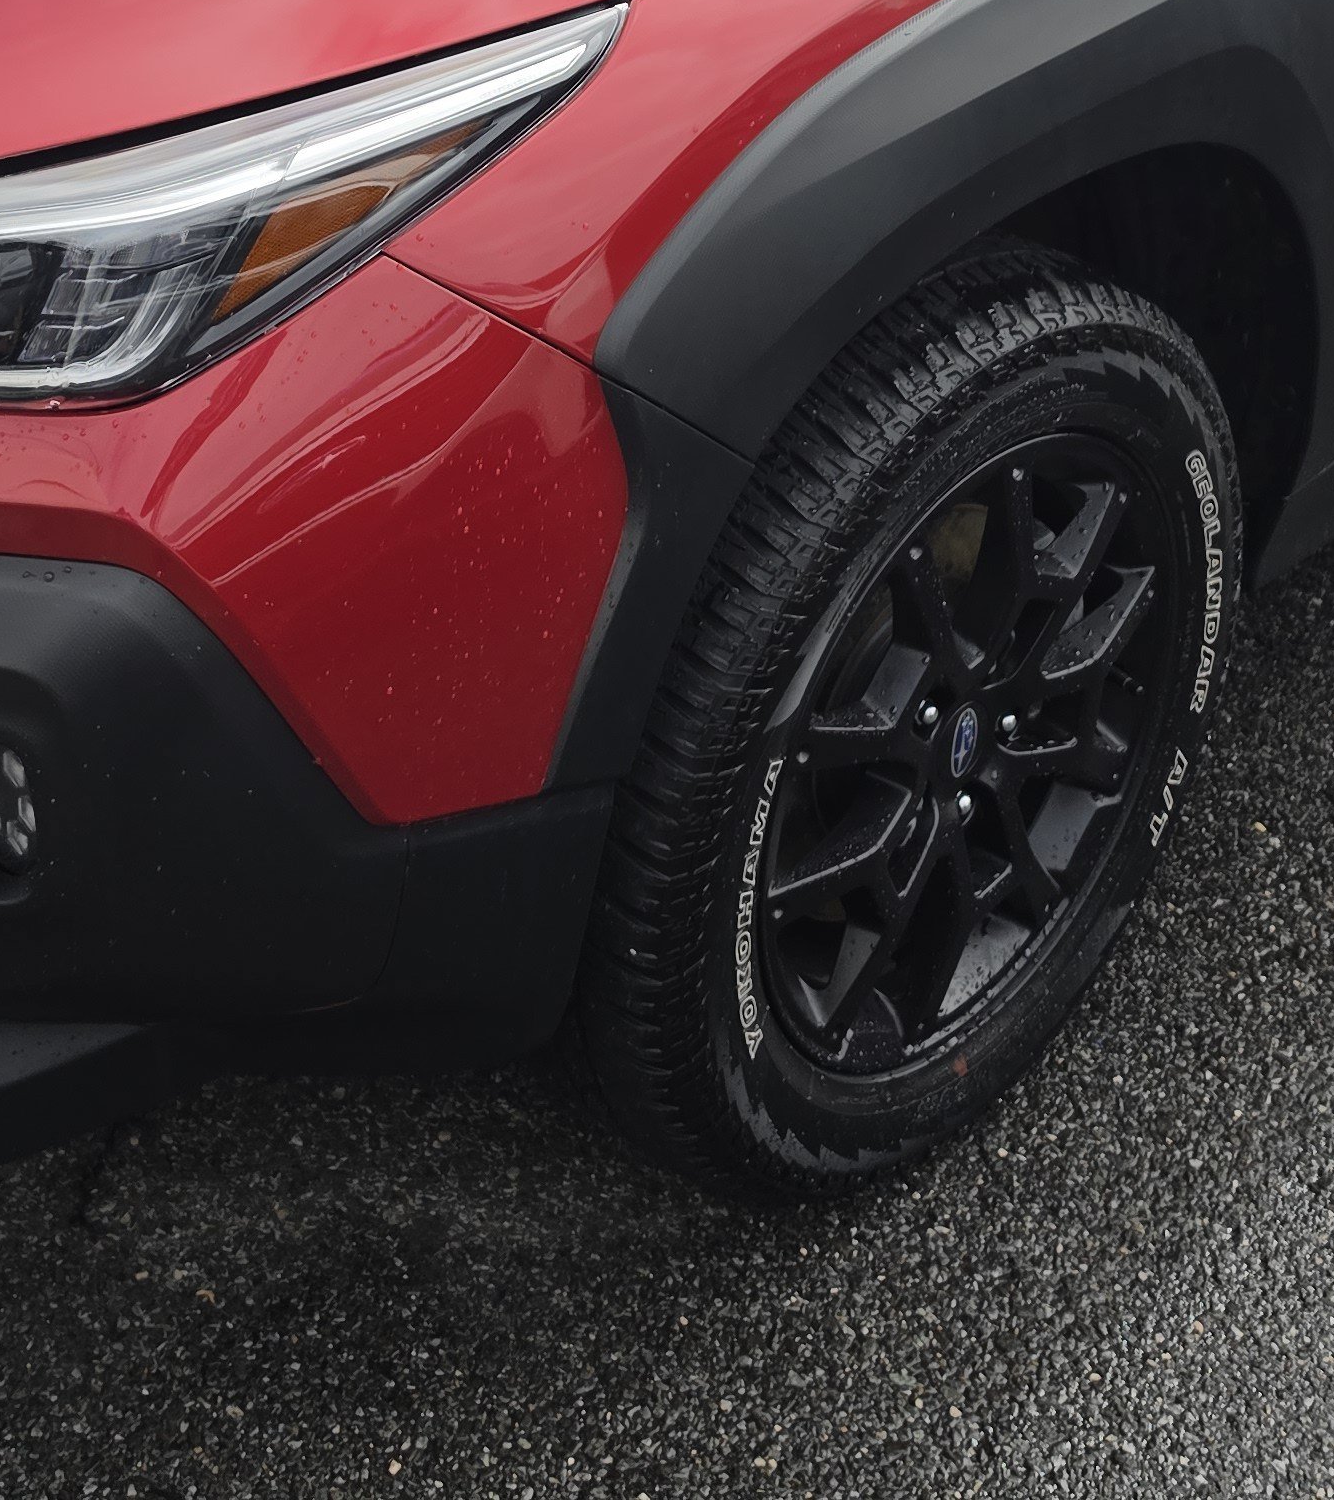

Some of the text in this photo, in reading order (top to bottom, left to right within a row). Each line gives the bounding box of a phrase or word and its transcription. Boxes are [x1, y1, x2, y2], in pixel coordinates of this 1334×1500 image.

[1152, 449, 1223, 847] GEOLANDAR A/T
[735, 758, 784, 1060] YOKOHAMA
